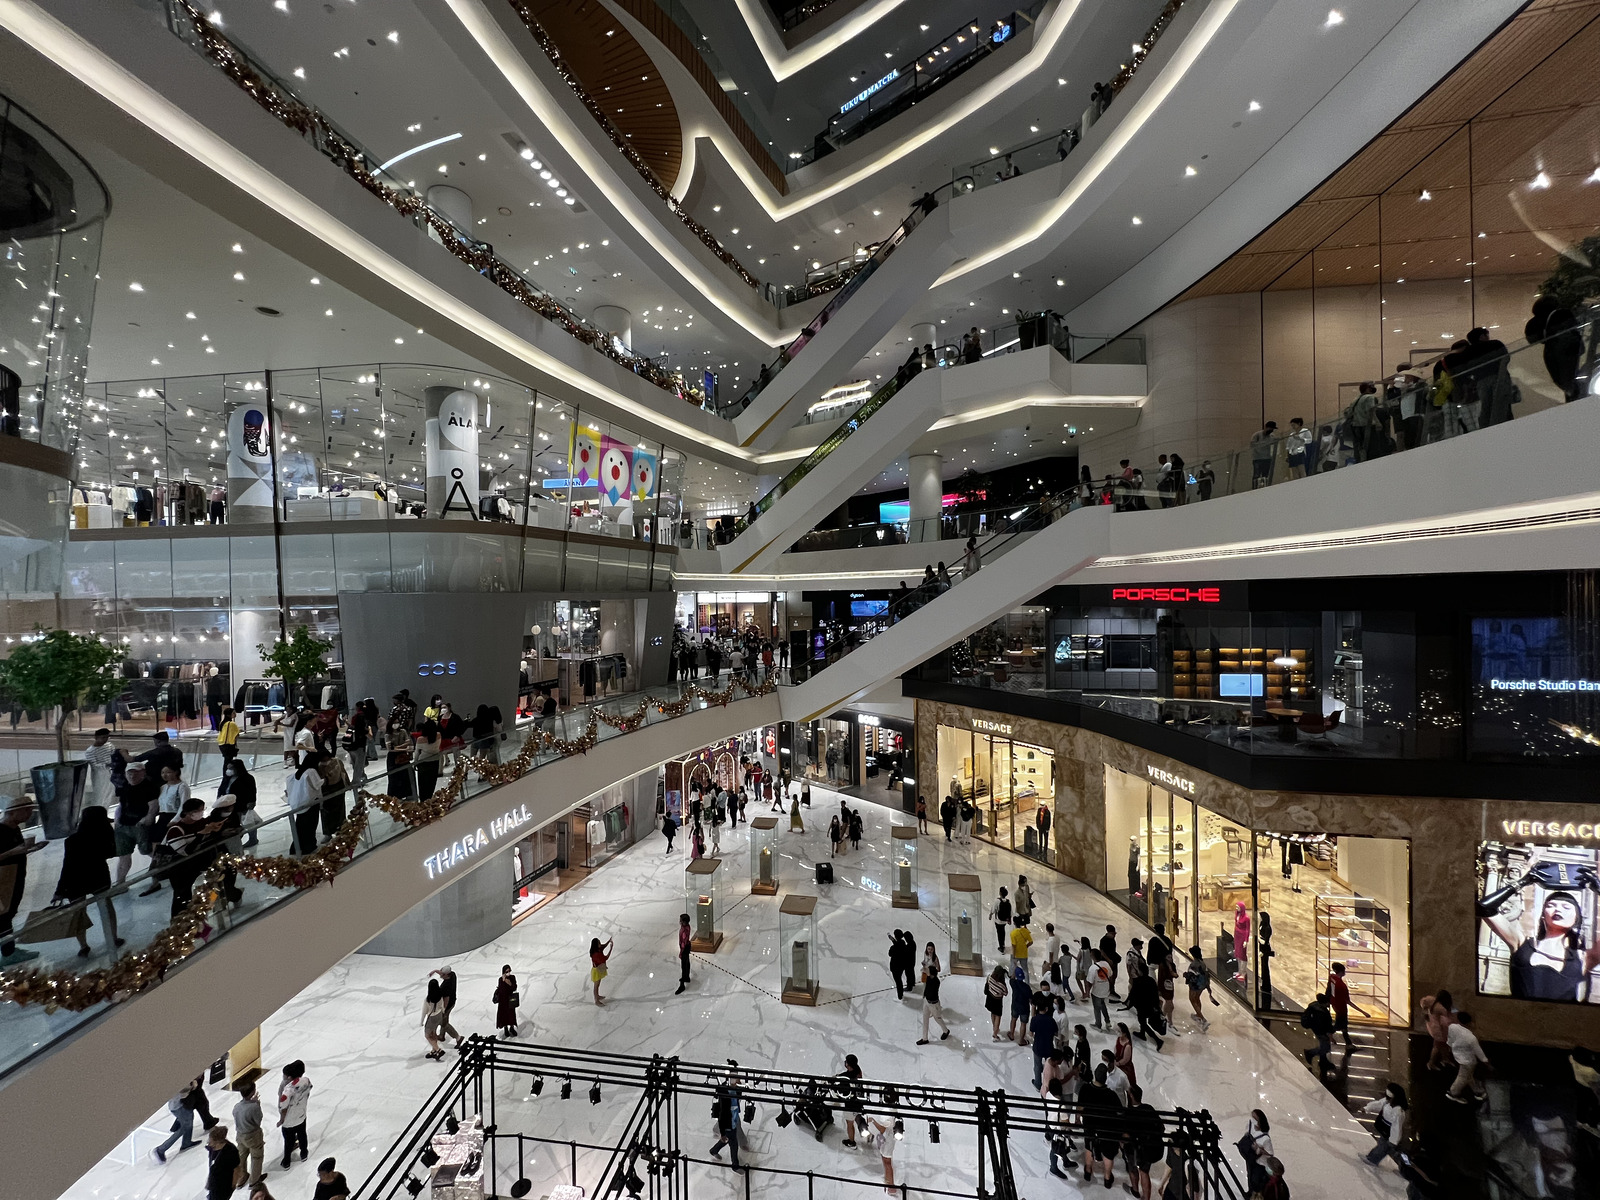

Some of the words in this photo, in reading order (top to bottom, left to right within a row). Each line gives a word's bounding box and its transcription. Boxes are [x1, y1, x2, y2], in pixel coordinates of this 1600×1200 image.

[867, 68, 899, 96] MATCHA
[448, 412, 476, 431] ÅLA
[1112, 587, 1220, 602] PORSCHE
[418, 662, 457, 677] COS
[1491, 679, 1536, 690] Porsche
[1538, 679, 1576, 690] Studio
[971, 718, 1012, 736] VERSACE
[1147, 765, 1195, 795] VERSACE
[424, 827, 489, 879] THARA
[490, 804, 533, 840] HALL
